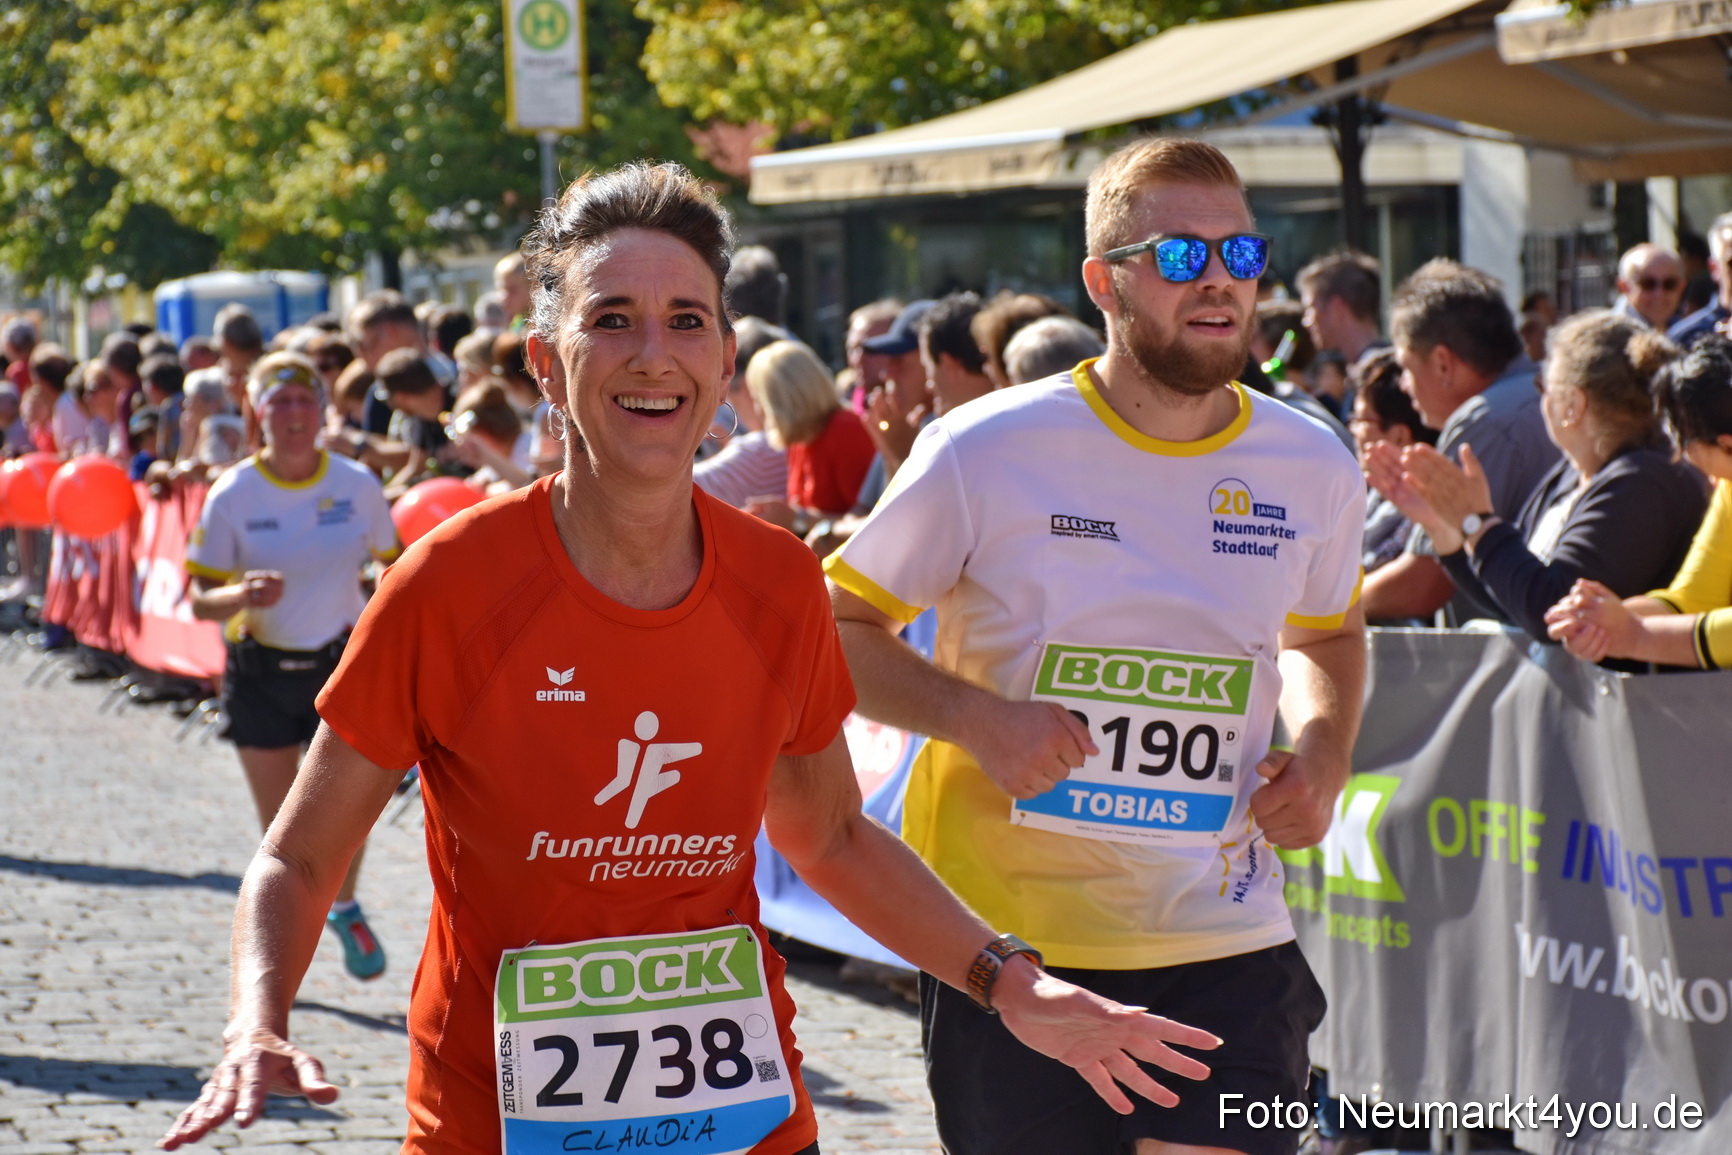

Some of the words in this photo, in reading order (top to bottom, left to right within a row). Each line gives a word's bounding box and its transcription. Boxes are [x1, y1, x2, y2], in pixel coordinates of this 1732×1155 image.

[1214, 488, 1250, 516] 20
[1256, 504, 1284, 519] JAHRE
[1051, 514, 1118, 538] BOCK
[1213, 520, 1296, 540] Neumarkter
[1212, 540, 1279, 560] Stadtlauf
[536, 687, 586, 702] erima
[1051, 651, 1238, 708] BOCK
[1067, 709, 1220, 781] 190
[1226, 731, 1236, 741] D
[1068, 788, 1189, 825] TOBIAS
[526, 830, 737, 861] funrunners
[517, 937, 745, 1014] BOCK
[533, 1018, 754, 1108] 2738
